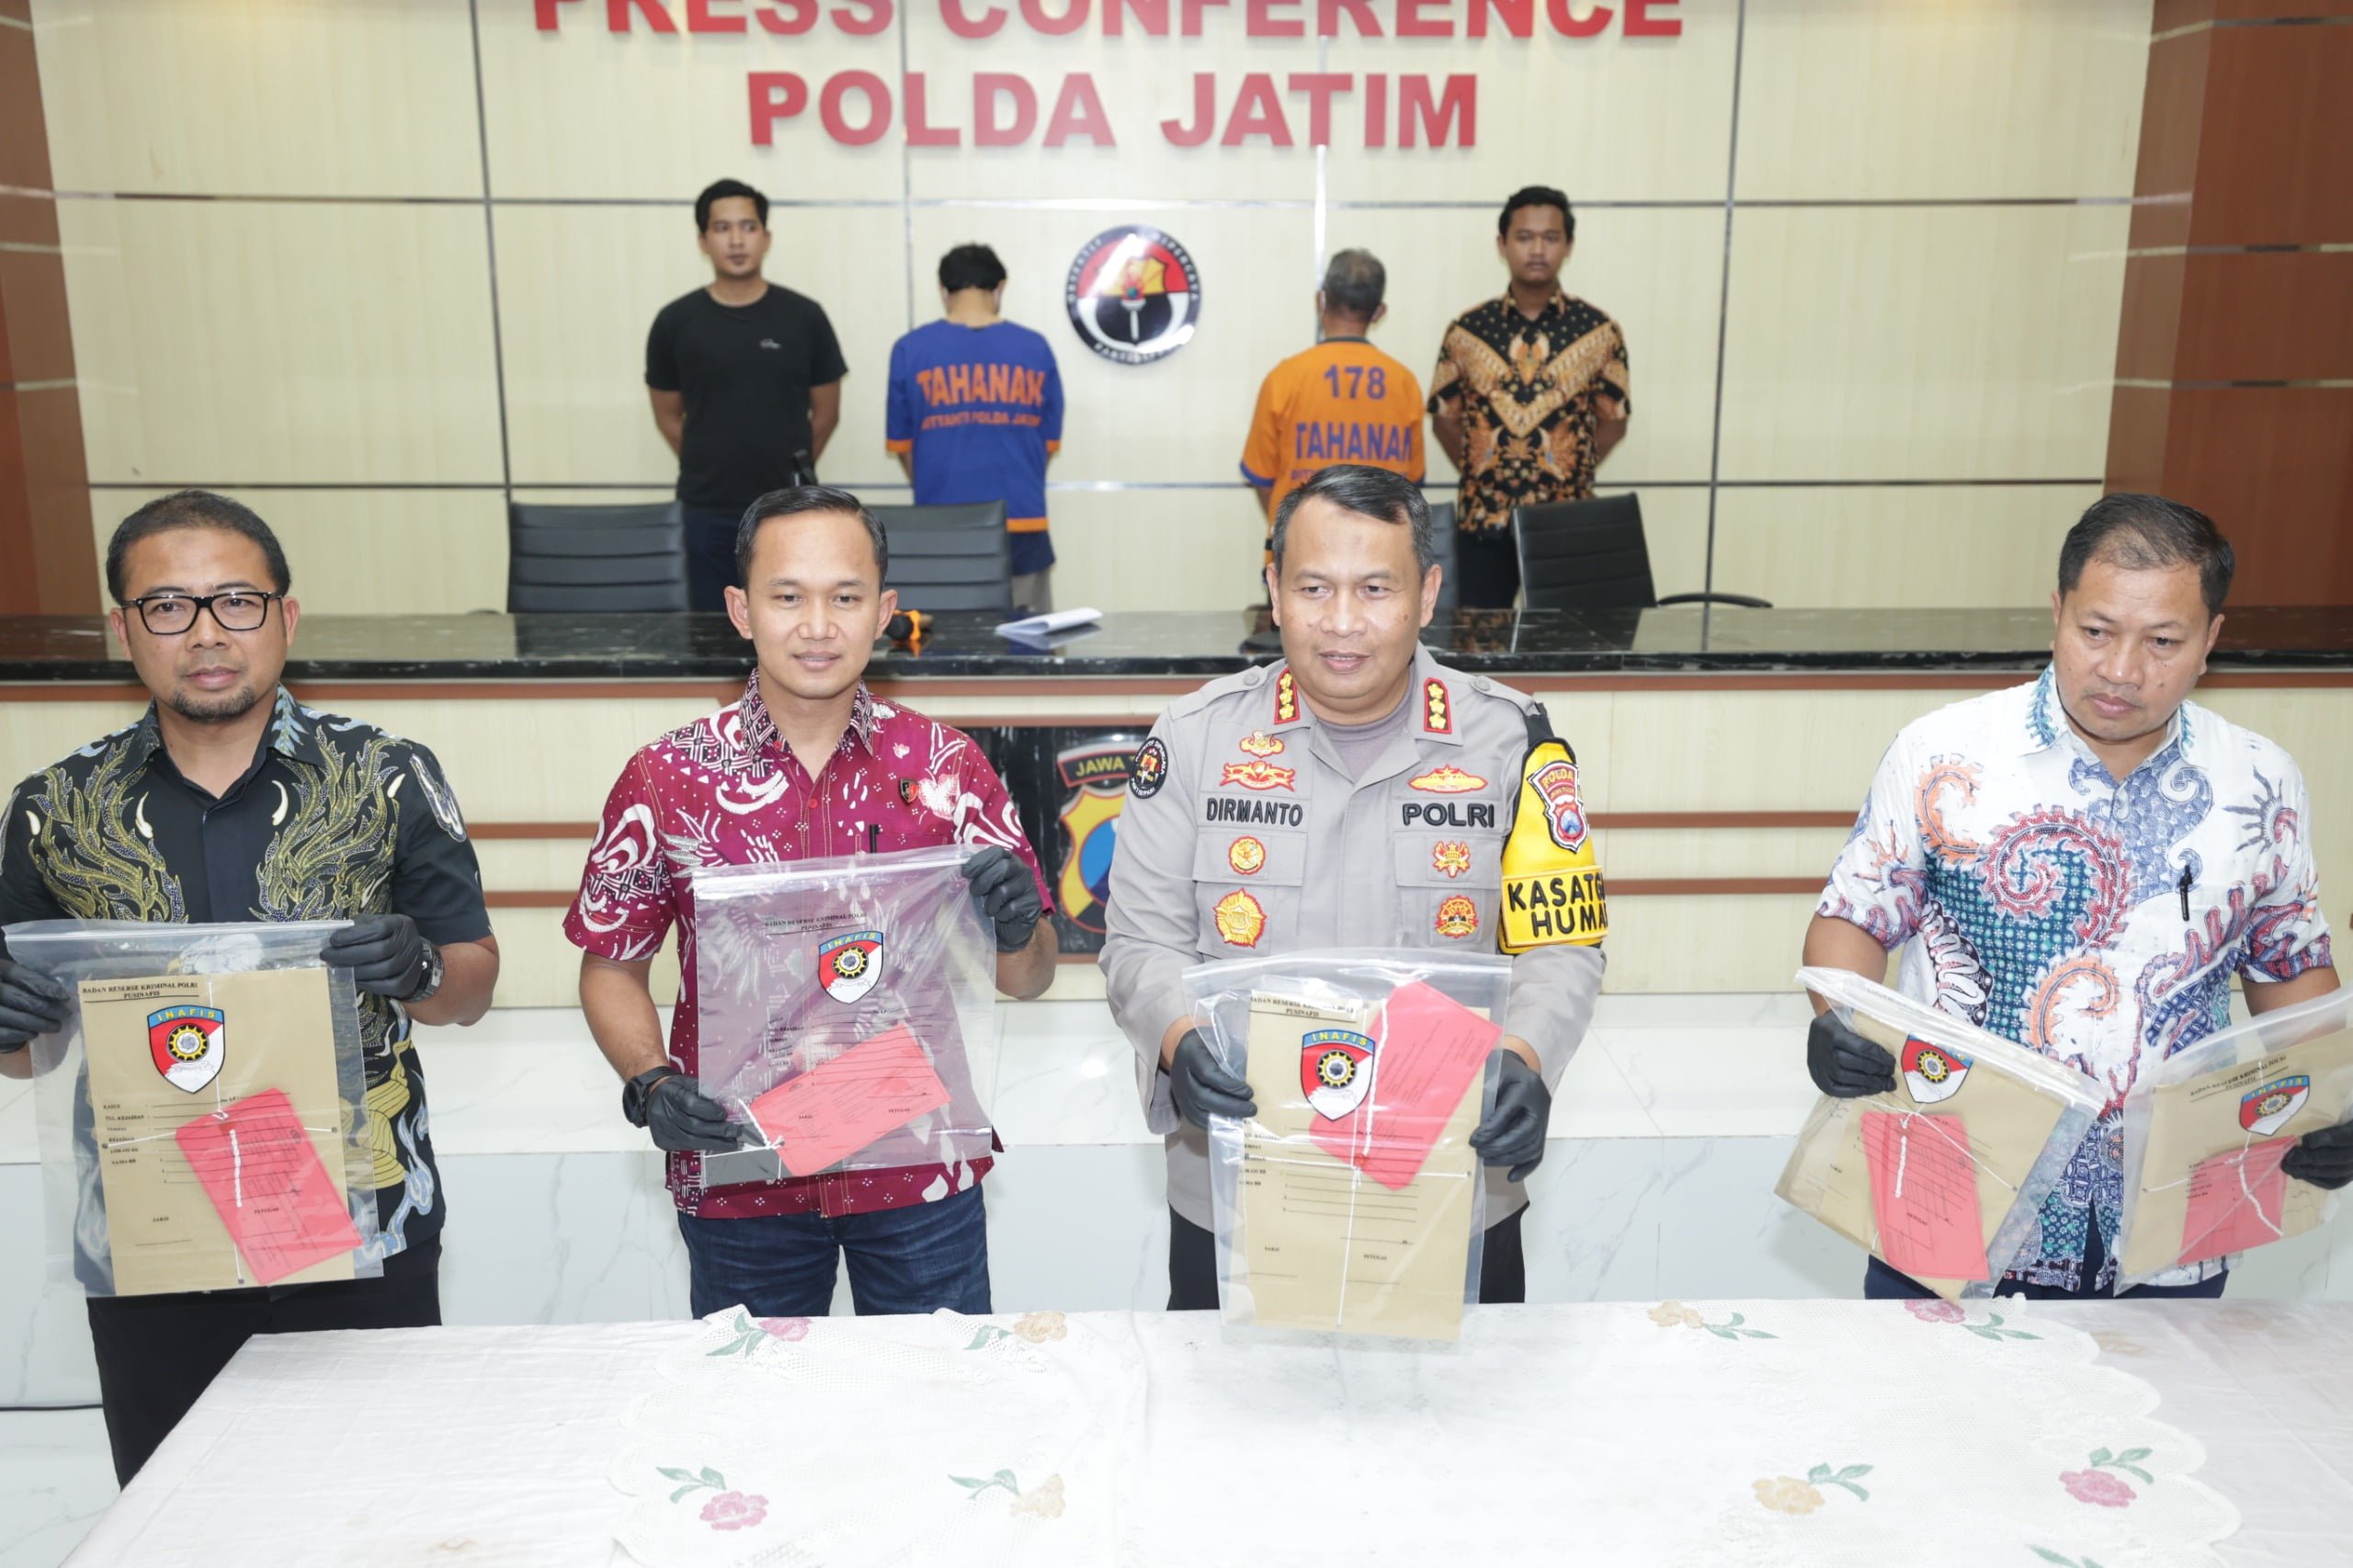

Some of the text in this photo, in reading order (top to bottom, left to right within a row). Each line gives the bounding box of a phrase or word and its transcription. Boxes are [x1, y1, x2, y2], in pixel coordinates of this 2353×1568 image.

[746, 70, 1477, 147] POLDA JATIM
[1324, 364, 1386, 400] 178
[1075, 755, 1126, 777] JAWA
[1540, 767, 1574, 789] POLDA
[1206, 797, 1303, 826] DIRMANTO
[1402, 801, 1495, 828] POLRI
[827, 931, 876, 949] INAFIS
[141, 983, 176, 991] KRIMINAL
[156, 1007, 216, 1022] INAFIS
[1312, 1031, 1369, 1046] INAFIS
[2251, 1077, 2303, 1097] INAFIS
